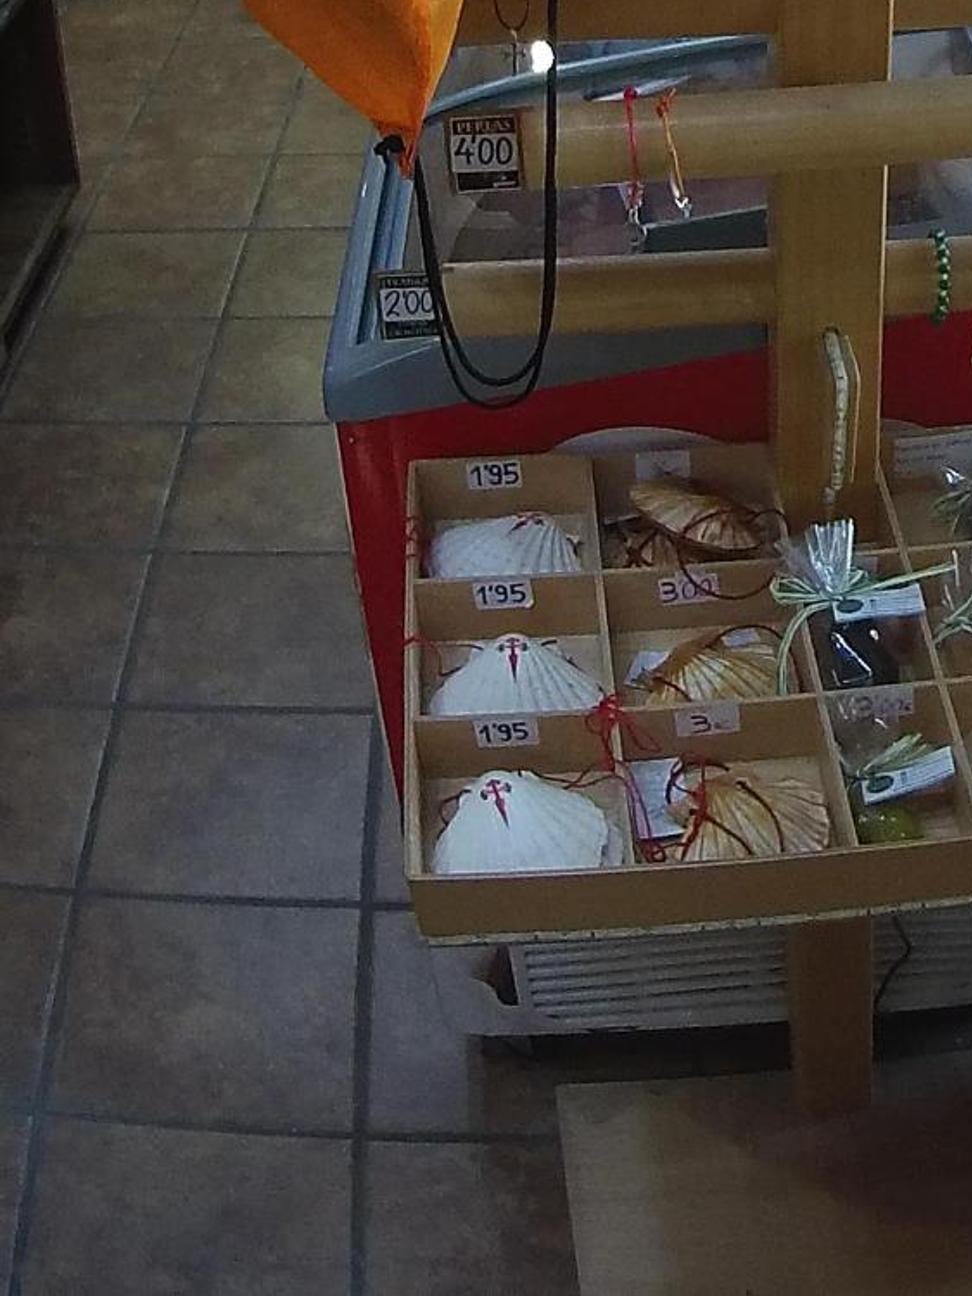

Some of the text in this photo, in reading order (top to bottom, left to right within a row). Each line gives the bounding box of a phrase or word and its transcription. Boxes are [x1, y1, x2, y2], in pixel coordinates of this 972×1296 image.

[456, 119, 512, 134] PERLAS
[453, 130, 514, 165] 4'00
[384, 290, 434, 317] 2'00
[469, 461, 521, 487] 1'95
[475, 583, 528, 604] 1'95
[477, 720, 531, 744] 1'95
